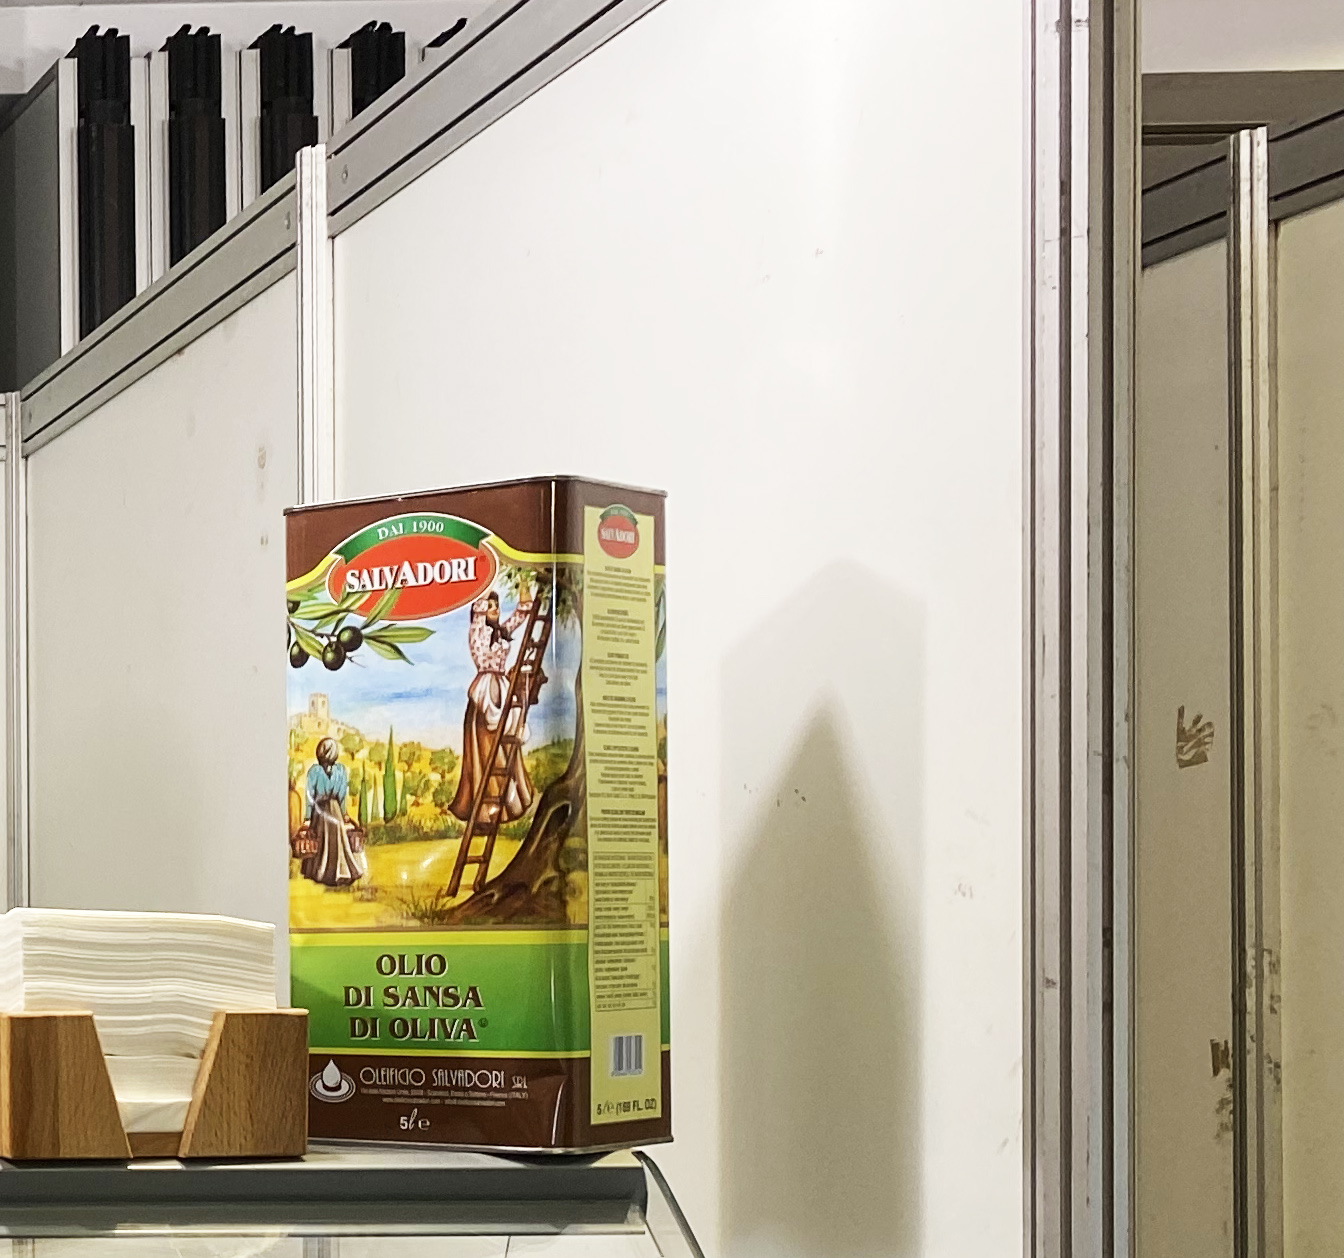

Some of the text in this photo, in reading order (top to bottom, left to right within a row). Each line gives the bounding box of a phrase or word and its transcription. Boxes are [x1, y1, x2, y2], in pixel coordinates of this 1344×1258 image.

[377, 519, 445, 541] DAL 1900
[345, 556, 478, 593] SALVADORI
[376, 953, 448, 978] OLIO
[343, 985, 485, 1009] DI SANSA
[349, 1016, 380, 1041] DI
[432, 1068, 505, 1089] SALVADORI
